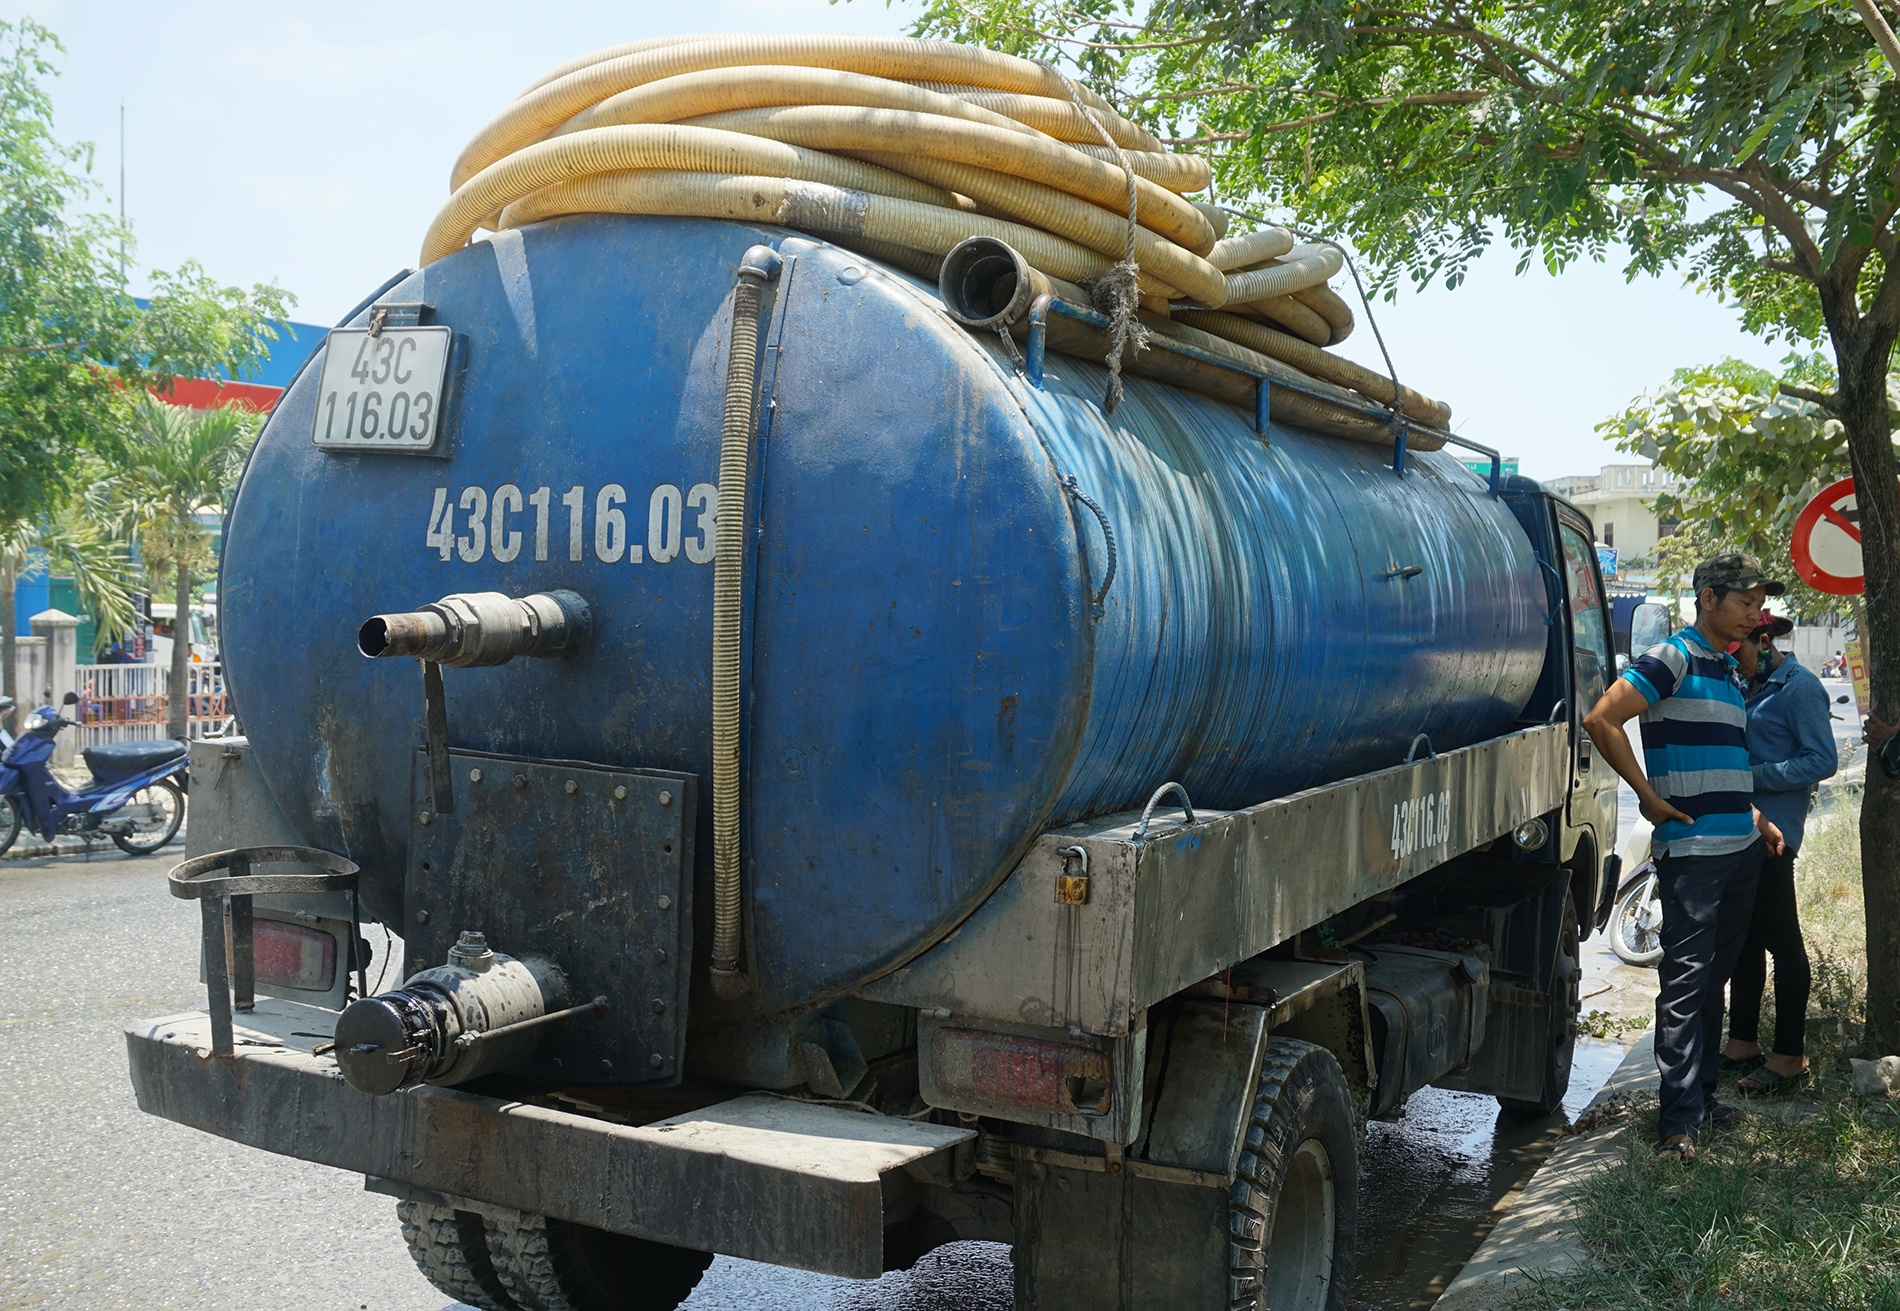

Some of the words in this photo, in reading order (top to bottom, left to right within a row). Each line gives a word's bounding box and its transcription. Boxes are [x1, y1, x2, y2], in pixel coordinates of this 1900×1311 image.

[351, 337, 416, 384] 43C
[326, 391, 433, 440] 116.03
[426, 483, 719, 563] 43C116.03
[1391, 789, 1450, 860] 43C116.03
